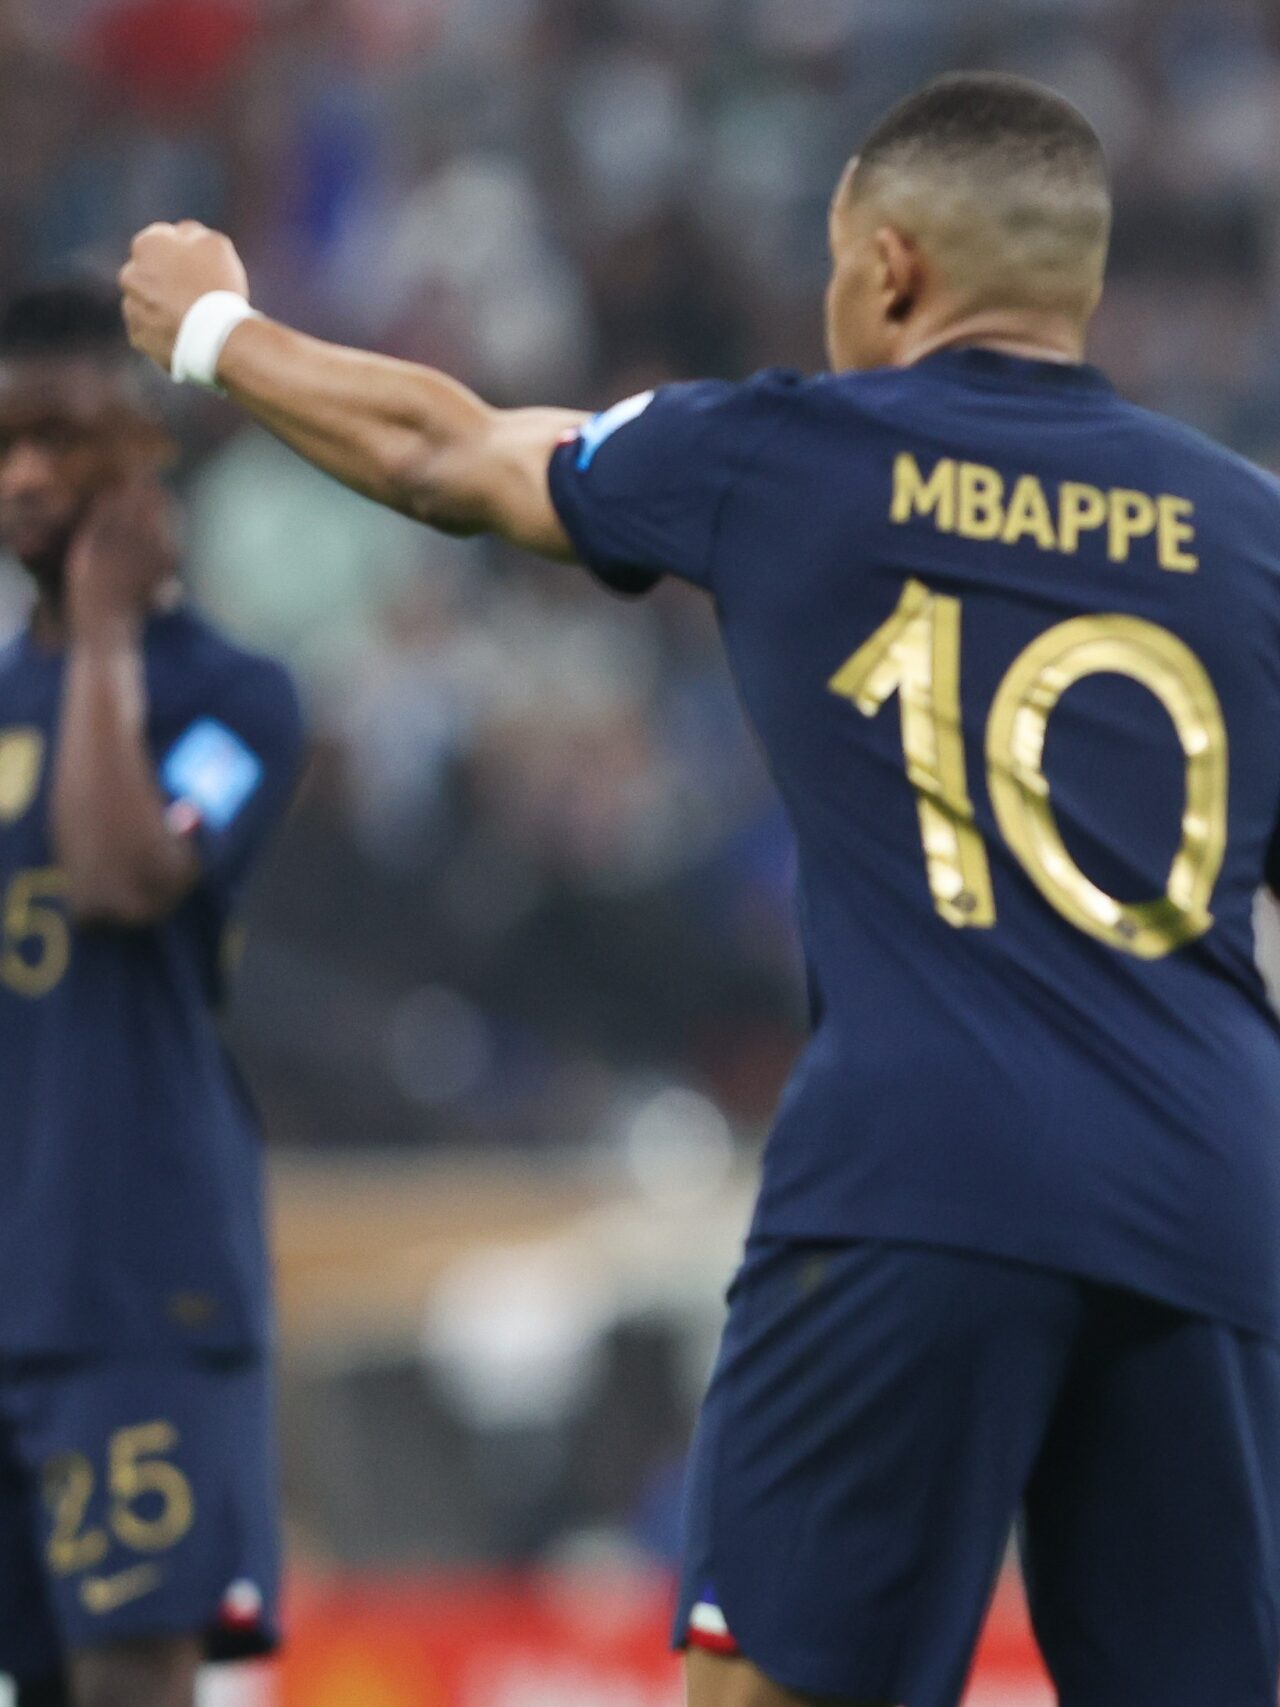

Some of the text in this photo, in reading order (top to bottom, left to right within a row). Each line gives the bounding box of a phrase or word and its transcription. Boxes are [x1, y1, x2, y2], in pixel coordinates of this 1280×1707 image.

[889, 451, 1199, 573] MBAPPE
[827, 576, 1229, 960] 10
[44, 1418, 194, 1576] 25
